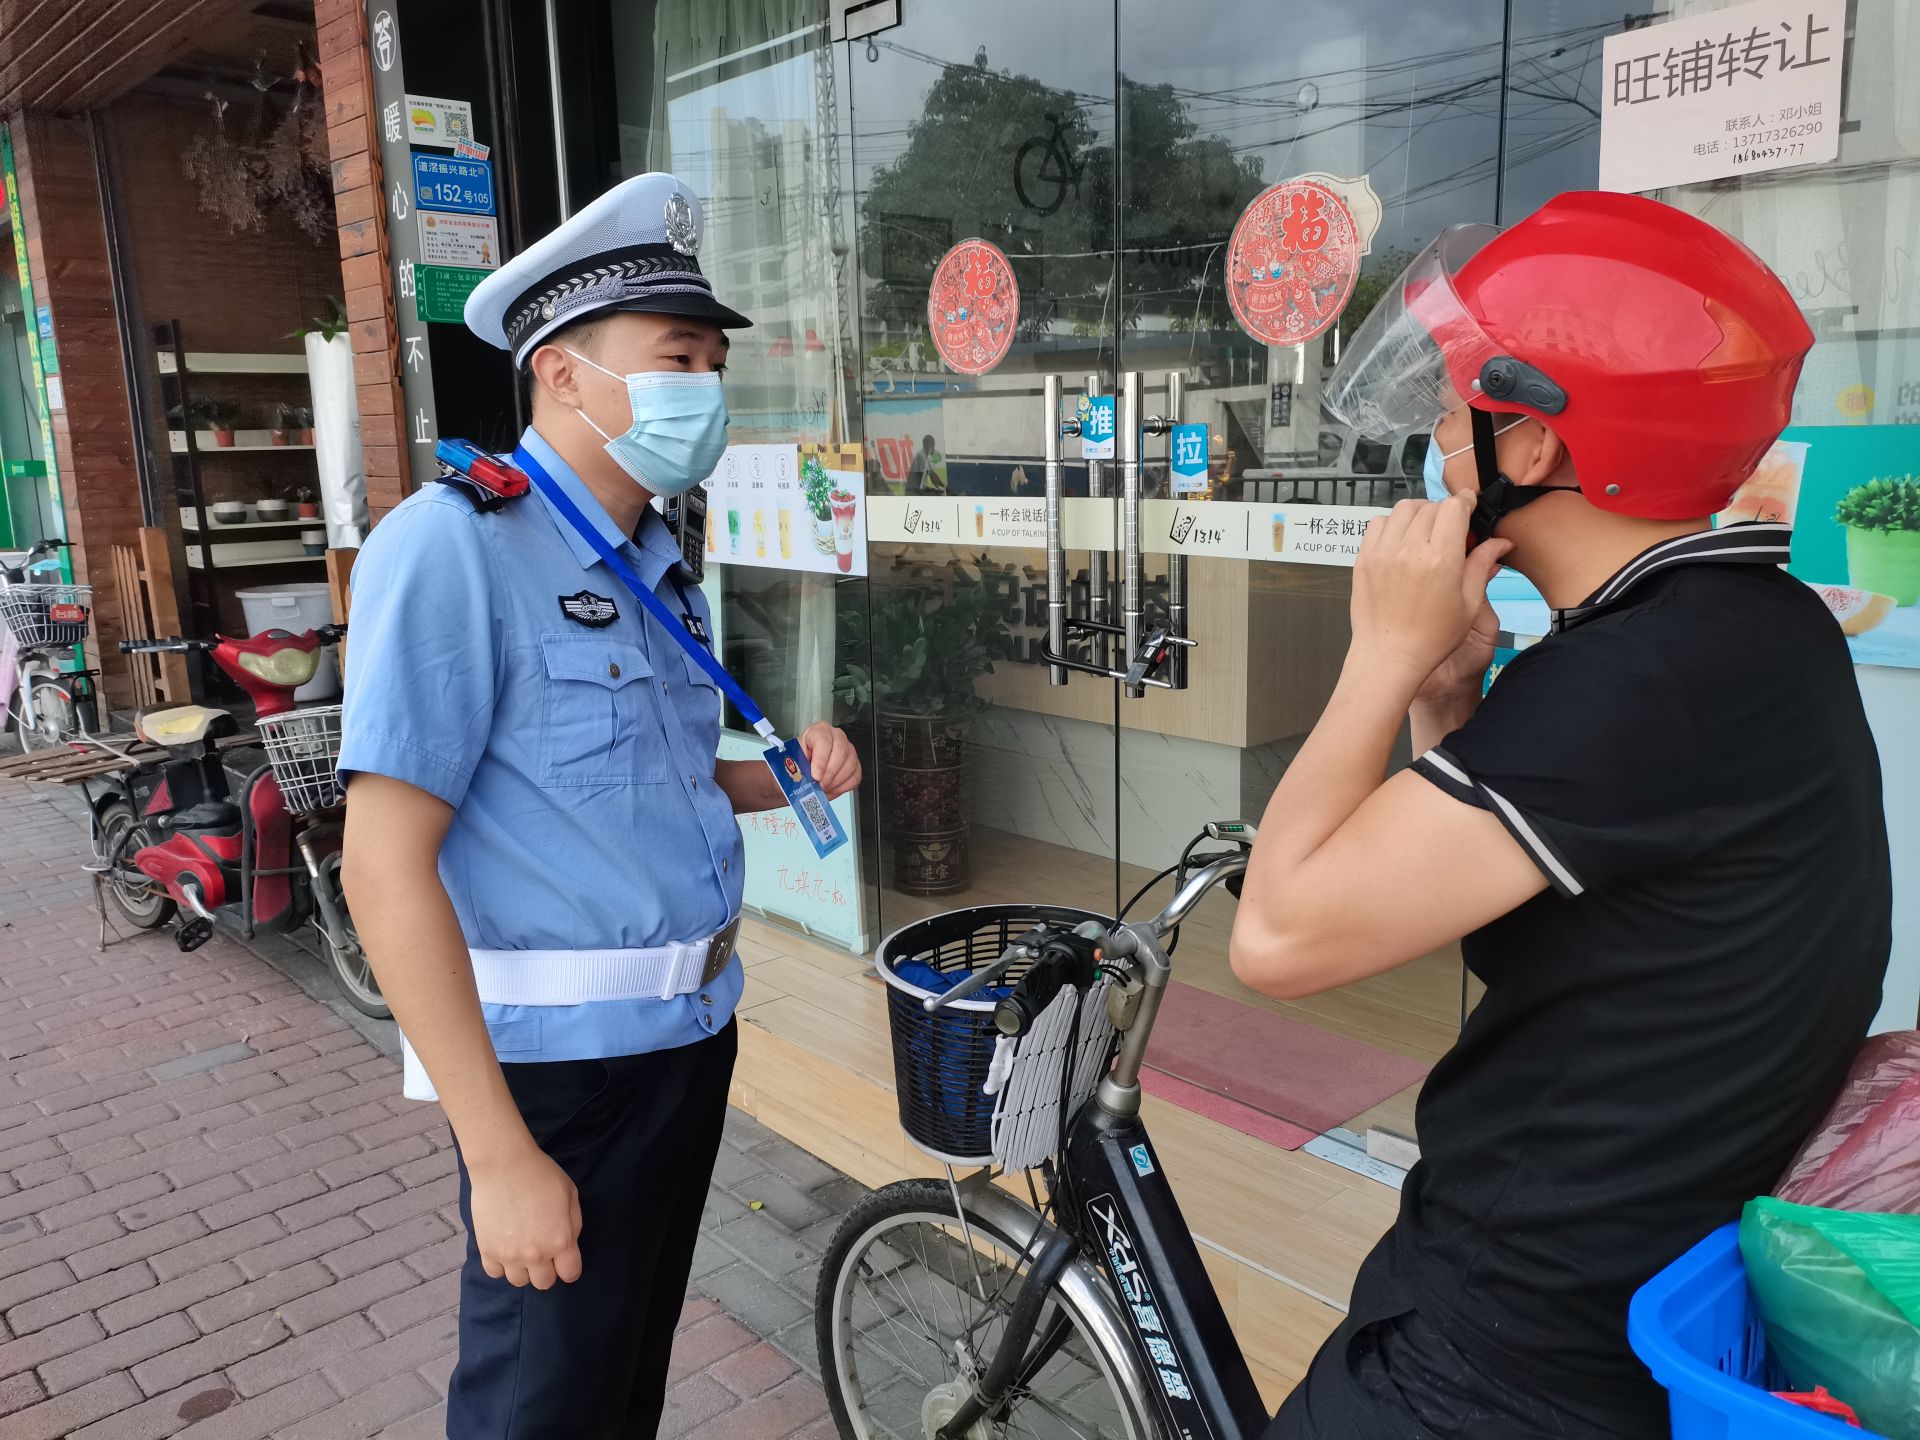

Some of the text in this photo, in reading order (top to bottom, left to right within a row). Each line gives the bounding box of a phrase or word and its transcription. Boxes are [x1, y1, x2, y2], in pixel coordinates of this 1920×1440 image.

[1613, 13, 1831, 107] 旺铺转让
[418, 161, 478, 178] 道滘振兴路北
[1281, 189, 1331, 253] 福
[963, 247, 997, 300] 福
[1090, 405, 1113, 435] 推
[1176, 431, 1204, 466] 拉
[1012, 529, 1020, 537] OF
[1294, 517, 1370, 537] 一杯会说话
[1295, 542, 1301, 551] A
[1303, 543, 1322, 552] CUP
[1325, 544, 1338, 553] OF
[1131, 1304, 1192, 1401] 喜德盛
